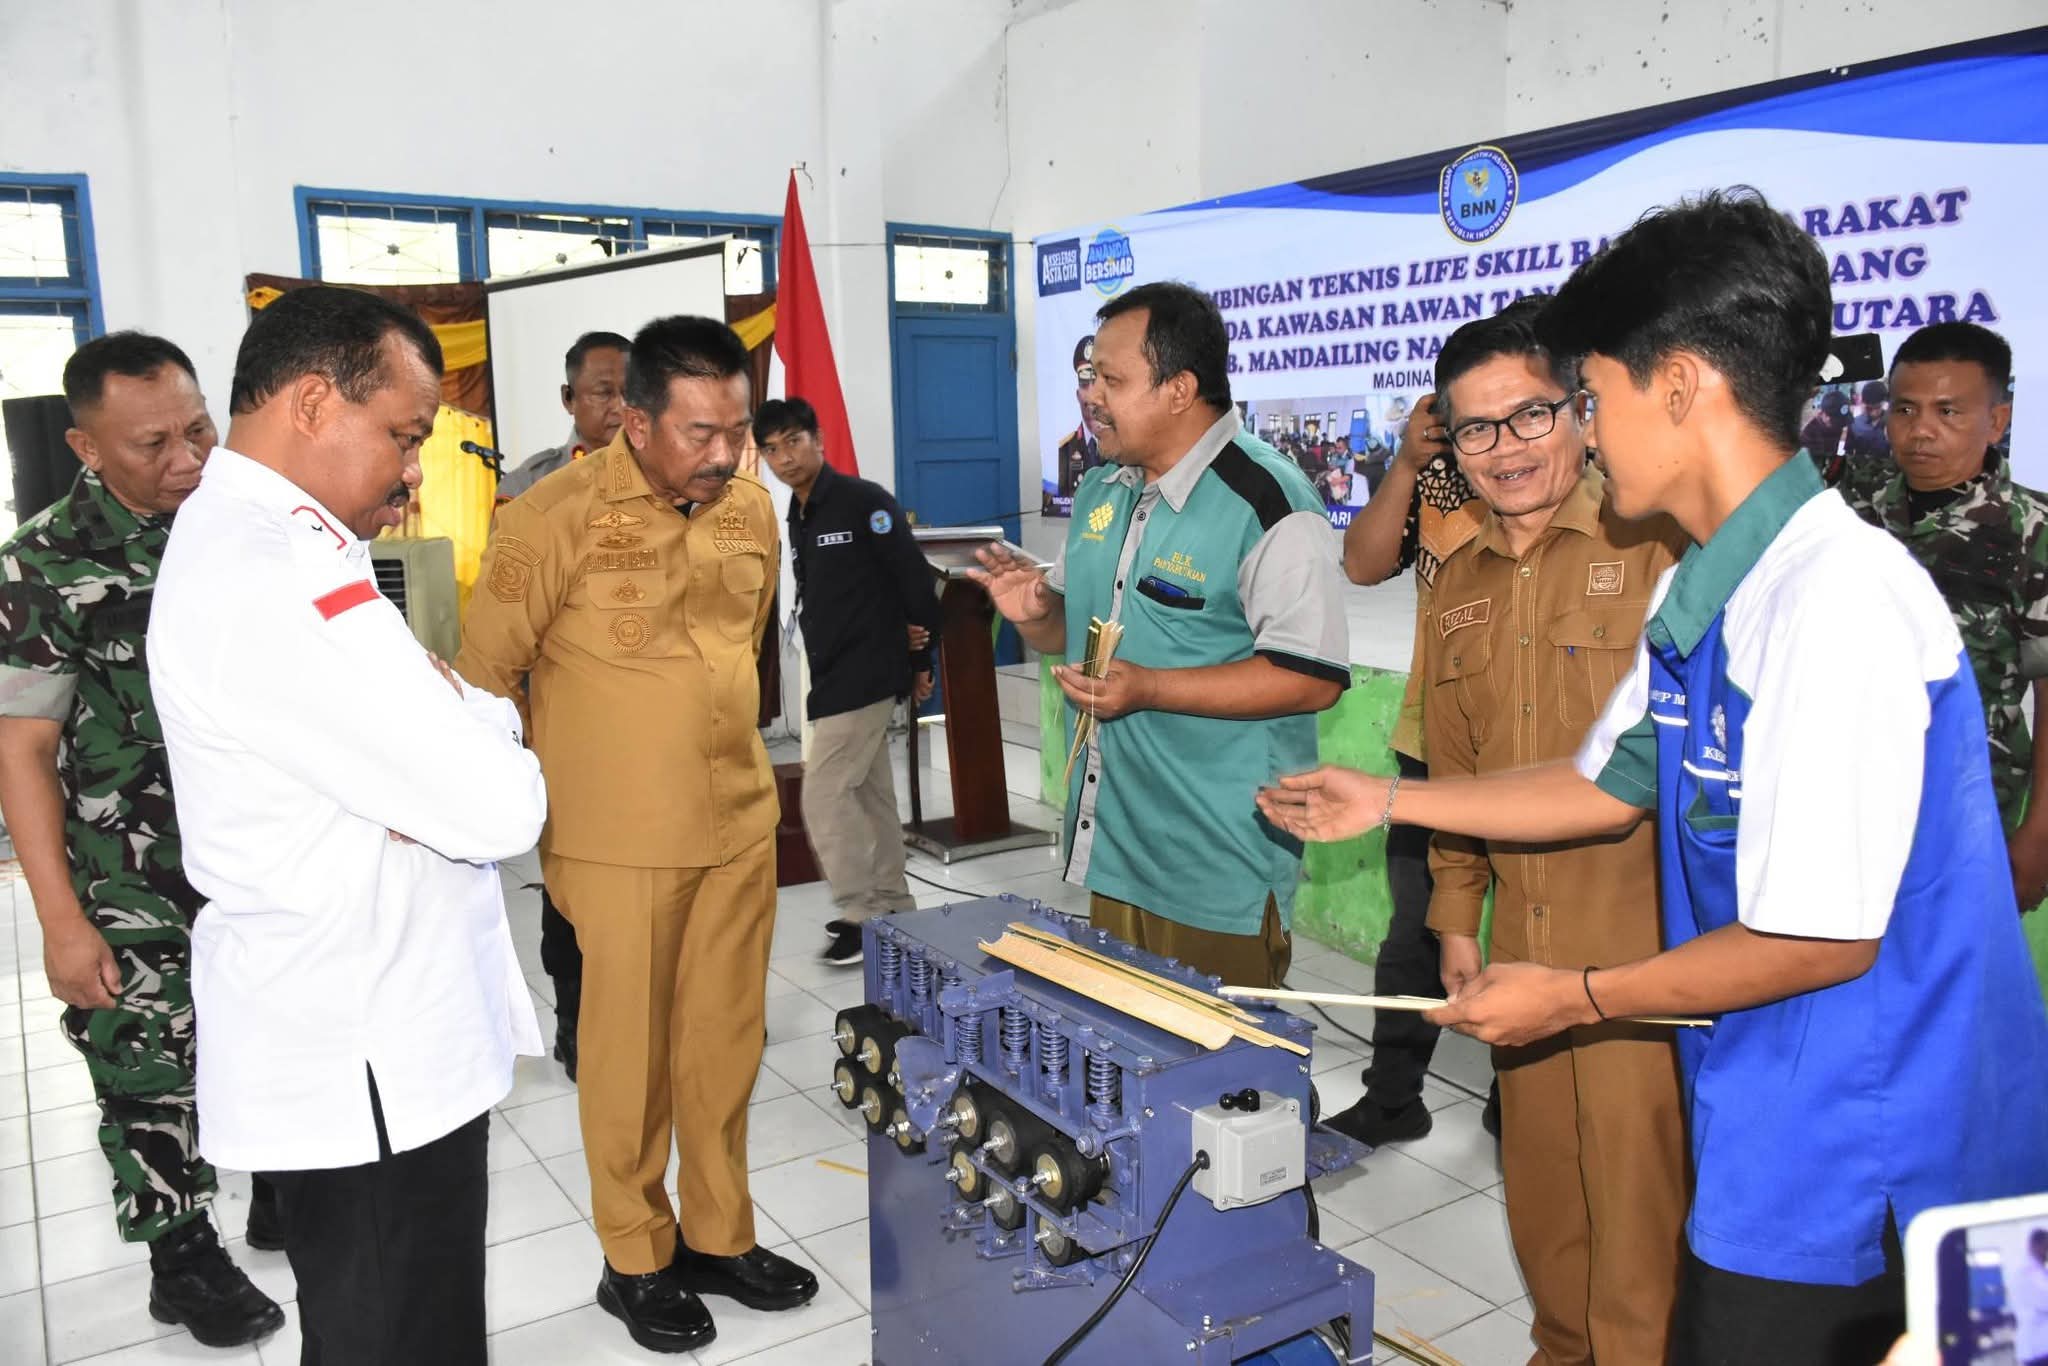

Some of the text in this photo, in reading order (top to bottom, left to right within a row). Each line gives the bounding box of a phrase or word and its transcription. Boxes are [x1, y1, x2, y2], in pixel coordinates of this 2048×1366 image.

[1444, 200, 1513, 240] REPUBLIK INDONESIA
[1460, 199, 1496, 219] BNN
[1309, 266, 1399, 298] TEKNIS
[1407, 256, 1469, 286] LIFE
[1475, 243, 1564, 278] SKILL
[1803, 190, 1968, 237] RAKAT
[1086, 256, 1133, 281] BERSINAR
[1224, 320, 1253, 341] DA
[1258, 305, 1376, 339] KAWASAN
[1382, 292, 1484, 326] RAWAN
[1830, 246, 1927, 284] ANG
[1227, 291, 1997, 374] B. MANDAILING NA UTARA
[1373, 368, 1433, 390] MADINA
